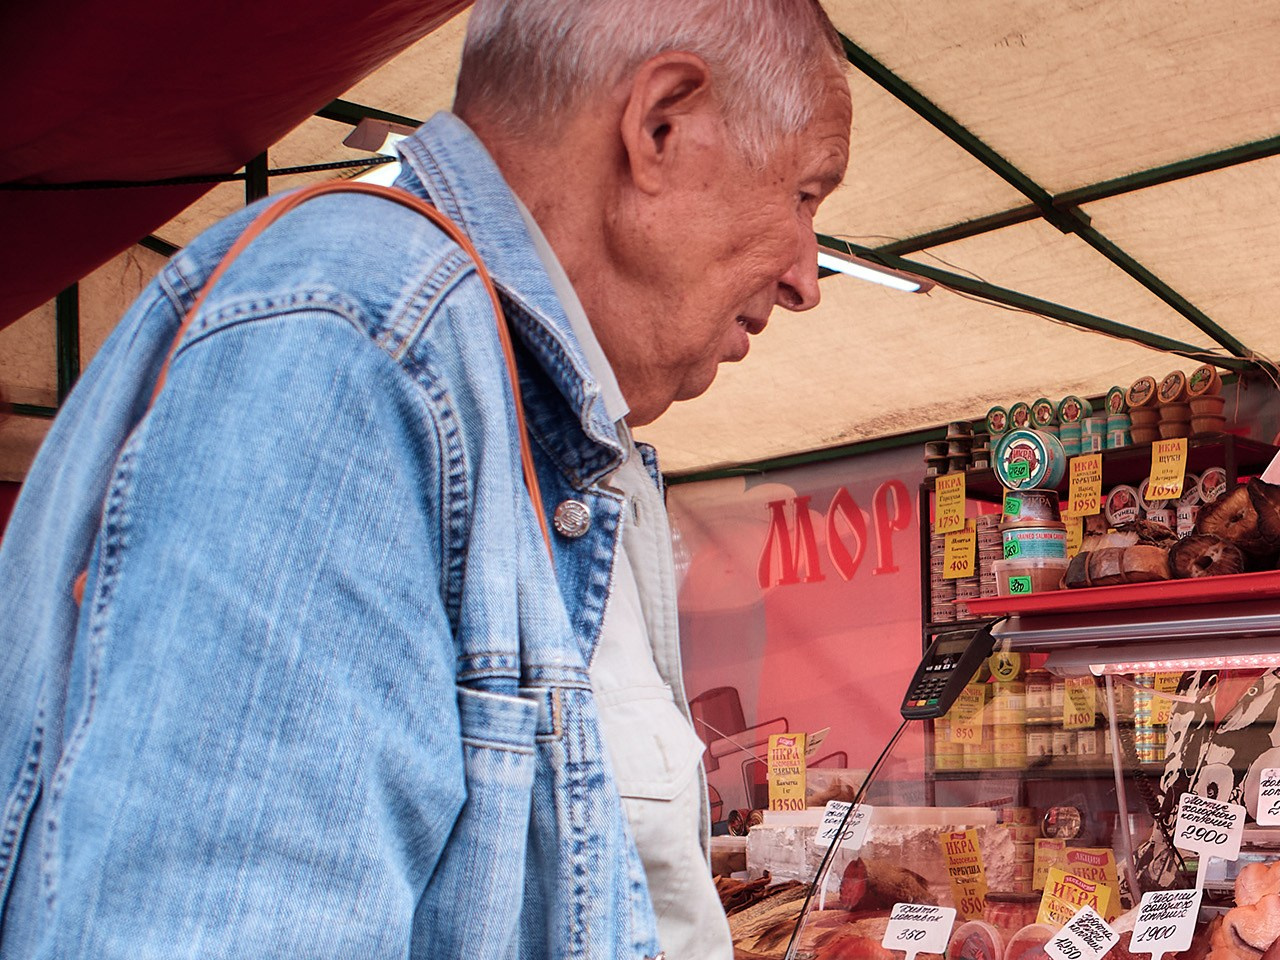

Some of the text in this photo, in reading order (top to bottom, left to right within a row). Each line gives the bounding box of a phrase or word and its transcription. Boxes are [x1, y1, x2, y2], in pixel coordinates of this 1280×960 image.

[1158, 443, 1181, 454] ИКРА
[1074, 459, 1099, 473] ИКРА
[1159, 454, 1181, 464] ЩУКИ
[938, 477, 962, 491] ИКРА
[1072, 475, 1101, 485] ГОРБУША
[1074, 498, 1097, 512] 1950
[938, 514, 960, 529] 1750
[1113, 509, 1135, 520] ТУНЕЦ
[1149, 516, 1165, 524] НЕЦ
[757, 479, 921, 590] МОР
[949, 559, 969, 572] 400
[1156, 711, 1172, 723] 85
[955, 727, 974, 740] 850
[772, 747, 800, 761] ИКРА
[771, 798, 804, 811] 13500
[1181, 804, 1237, 821] холодного
[1180, 813, 1235, 830] копчения
[1180, 824, 1229, 845] 2900
[945, 839, 976, 855] ИКРА
[948, 865, 982, 877] ГОРБУША
[1073, 867, 1107, 881] ИКРА
[1052, 881, 1099, 912] ИКРА
[1140, 900, 1194, 914] холодного
[896, 928, 927, 941] 350
[1136, 924, 1177, 943] 1900
[1054, 937, 1082, 960] 1250
